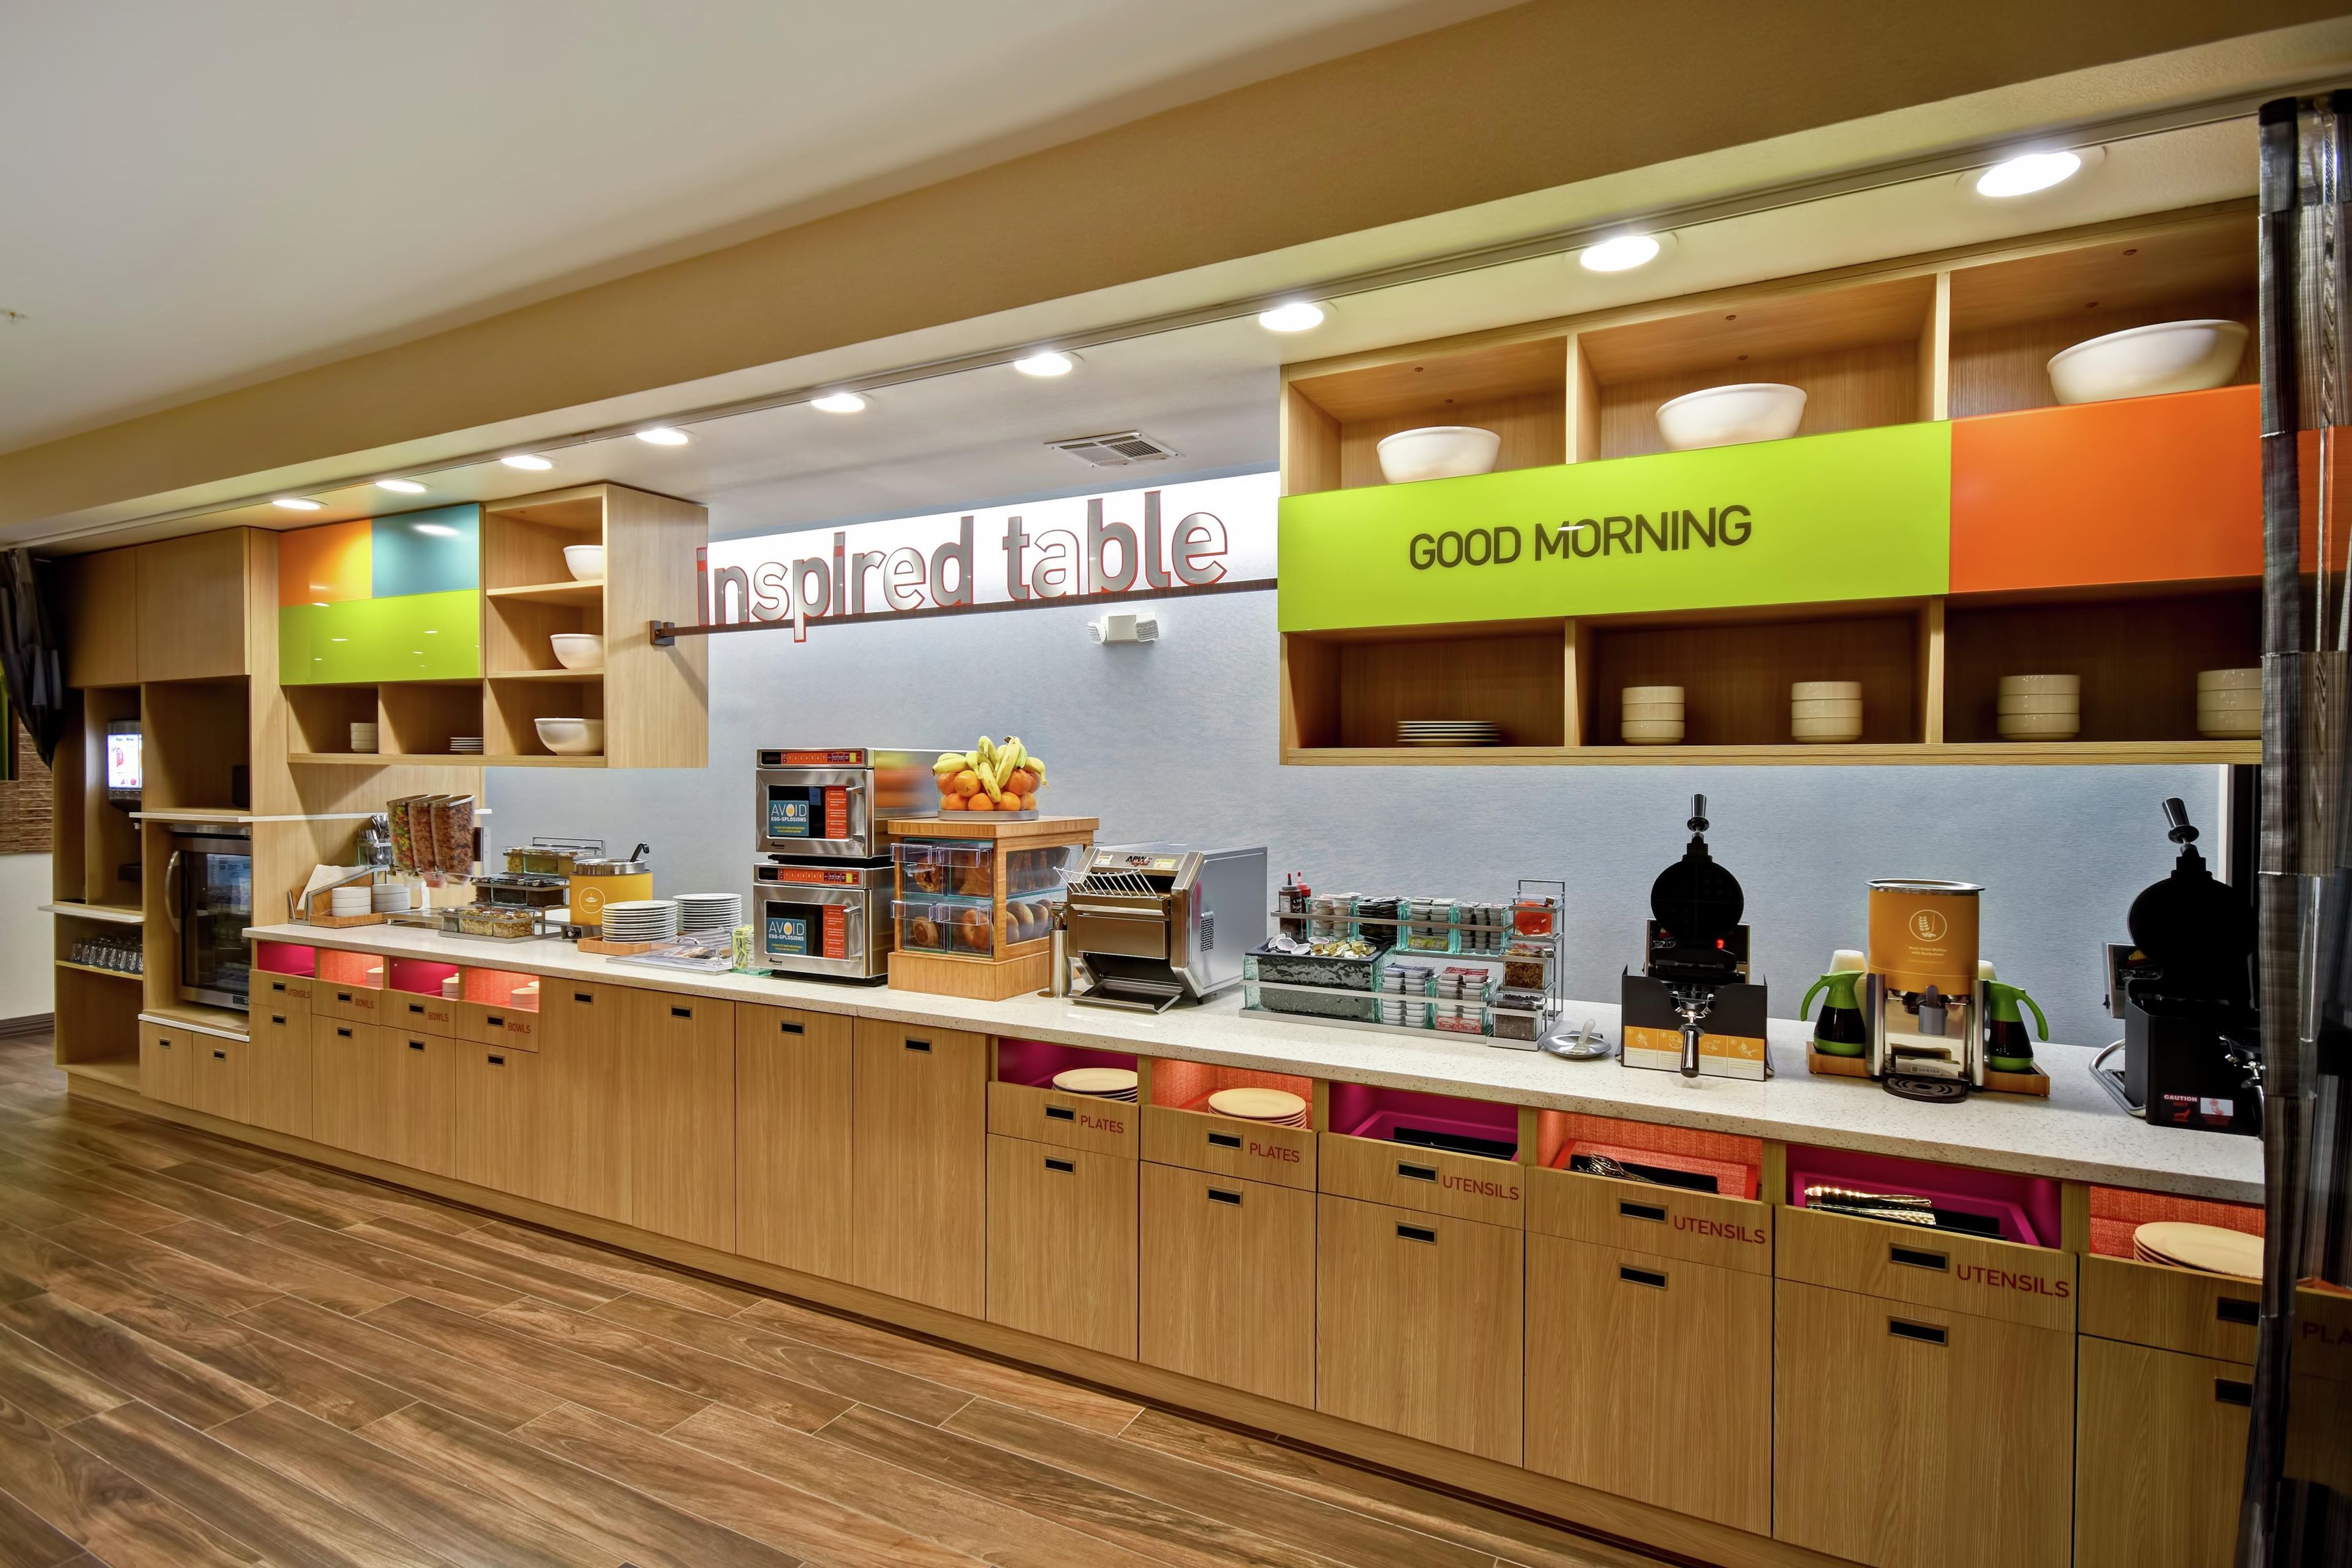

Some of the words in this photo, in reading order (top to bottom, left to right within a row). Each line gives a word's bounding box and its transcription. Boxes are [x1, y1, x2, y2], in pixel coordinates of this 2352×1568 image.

[1410, 526, 1521, 570] GOOD
[1535, 505, 1751, 562] MORNING
[696, 516, 974, 643] inspired
[1003, 491, 1227, 601] table
[771, 804, 807, 817] AVOID
[769, 921, 804, 935] AVOID
[287, 989, 311, 998] UTENSILS
[355, 998, 374, 1009] BOWLS
[428, 1012, 449, 1022] BOWLS
[508, 1022, 530, 1033] BOWLS
[1080, 1115, 1124, 1134] PLATES
[1250, 1142, 1300, 1163] PLATES
[1443, 1175, 1519, 1200] UTENSILS
[1674, 1215, 1766, 1244] UTENSILS
[1957, 1264, 2069, 1298] UTENSILS
